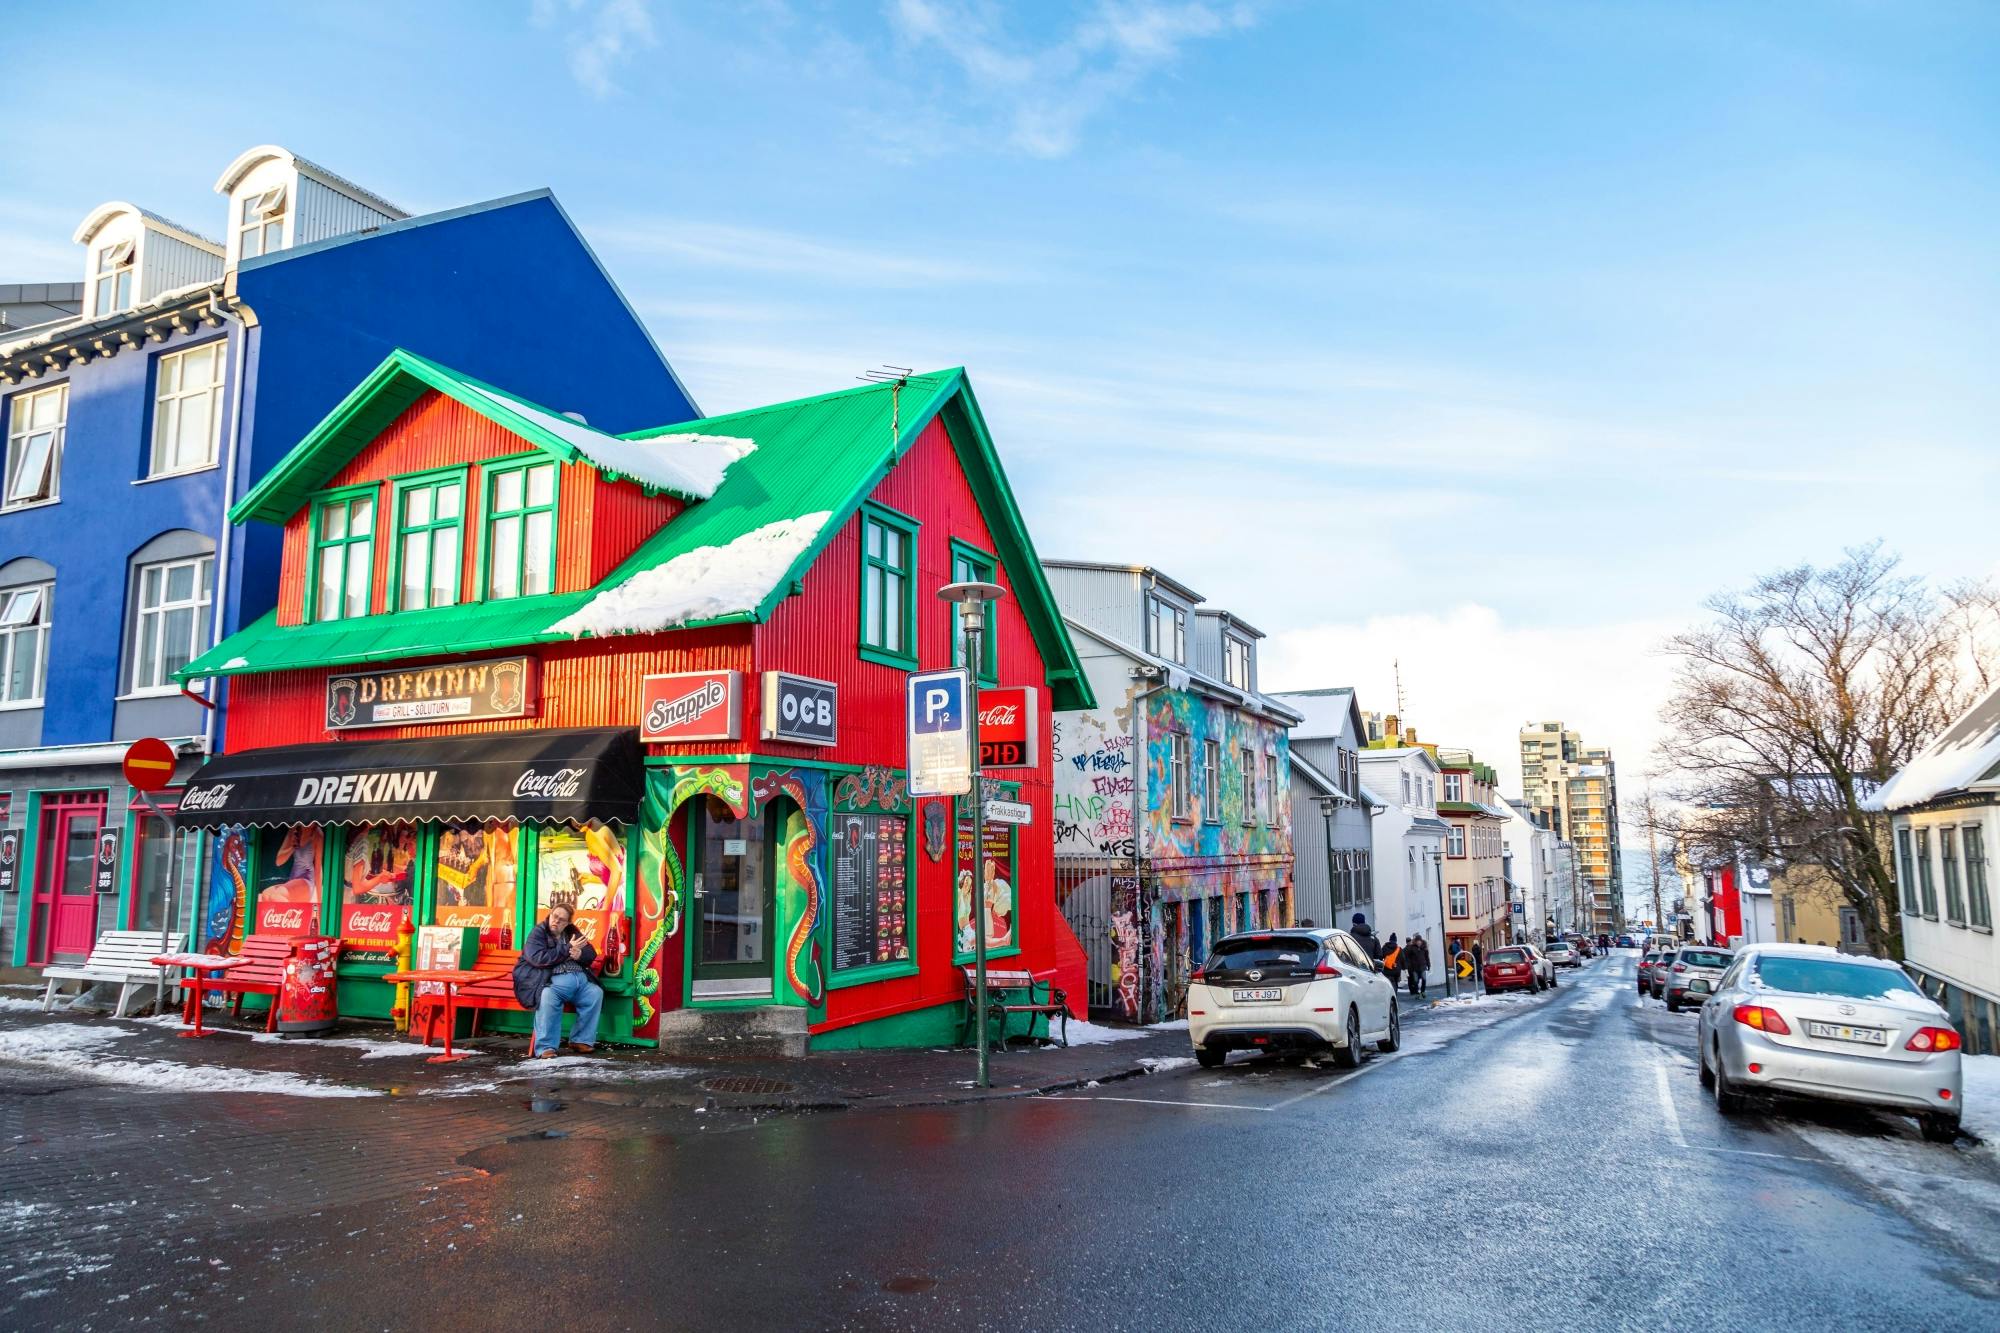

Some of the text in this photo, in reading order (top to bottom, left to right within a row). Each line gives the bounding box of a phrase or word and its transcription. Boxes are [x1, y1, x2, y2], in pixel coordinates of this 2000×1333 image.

[359, 666, 489, 703] DREKINN
[648, 681, 722, 729] Snapple
[782, 693, 832, 727] OCB
[978, 704, 1019, 726] a-Cola
[980, 743, 1019, 765] PIÐ
[294, 770, 437, 806] DREKINN
[512, 768, 587, 798] Coca-Cola
[179, 783, 236, 811] Coca-Cola
[263, 908, 304, 929] Coca-Cola
[349, 911, 393, 932] Coca-Cola
[367, 953, 377, 961] ice
[1241, 991, 1278, 999] LK J97
[1820, 1024, 1882, 1042] NT F74
